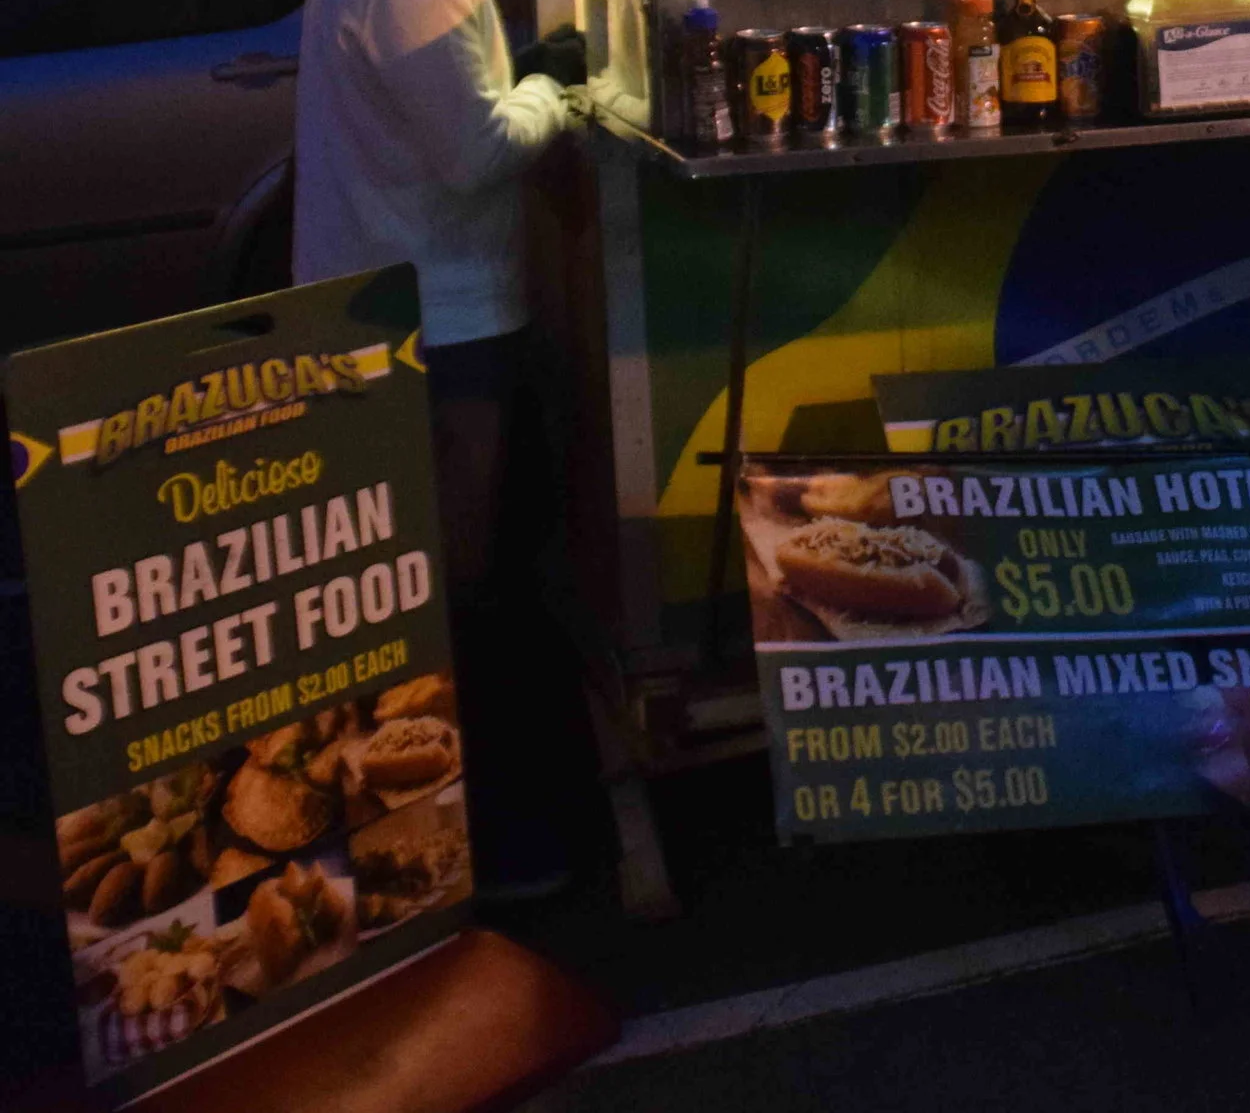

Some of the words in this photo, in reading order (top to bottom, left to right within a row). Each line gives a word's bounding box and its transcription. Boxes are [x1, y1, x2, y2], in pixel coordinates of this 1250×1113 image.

[756, 74, 791, 97] L&P
[820, 66, 832, 105] zero
[96, 351, 367, 465] BRAZUCA'S
[164, 414, 258, 455] BRAZILIAN
[258, 401, 308, 427] FOOD
[156, 451, 325, 523] Delicioso
[889, 471, 1143, 518] BRAZILIAN
[91, 481, 394, 637] BRAZILIAN
[1018, 529, 1087, 559] ONLY
[996, 556, 1135, 622] $5.00
[61, 601, 279, 736] STREET
[294, 550, 433, 650] FOOD
[126, 710, 222, 773] SNACKS
[226, 691, 293, 734] FROM
[297, 663, 351, 707] $2.00
[353, 638, 409, 687] EACH
[780, 657, 1042, 710] BRAZILIAN
[1056, 651, 1196, 695] MIXED
[786, 723, 883, 762] FROM
[893, 718, 968, 755] $2.00
[979, 714, 1056, 750] EACH
[795, 787, 840, 819] OR
[850, 784, 871, 816] 4
[882, 778, 943, 812] FOR
[953, 766, 1048, 810] $5.00
